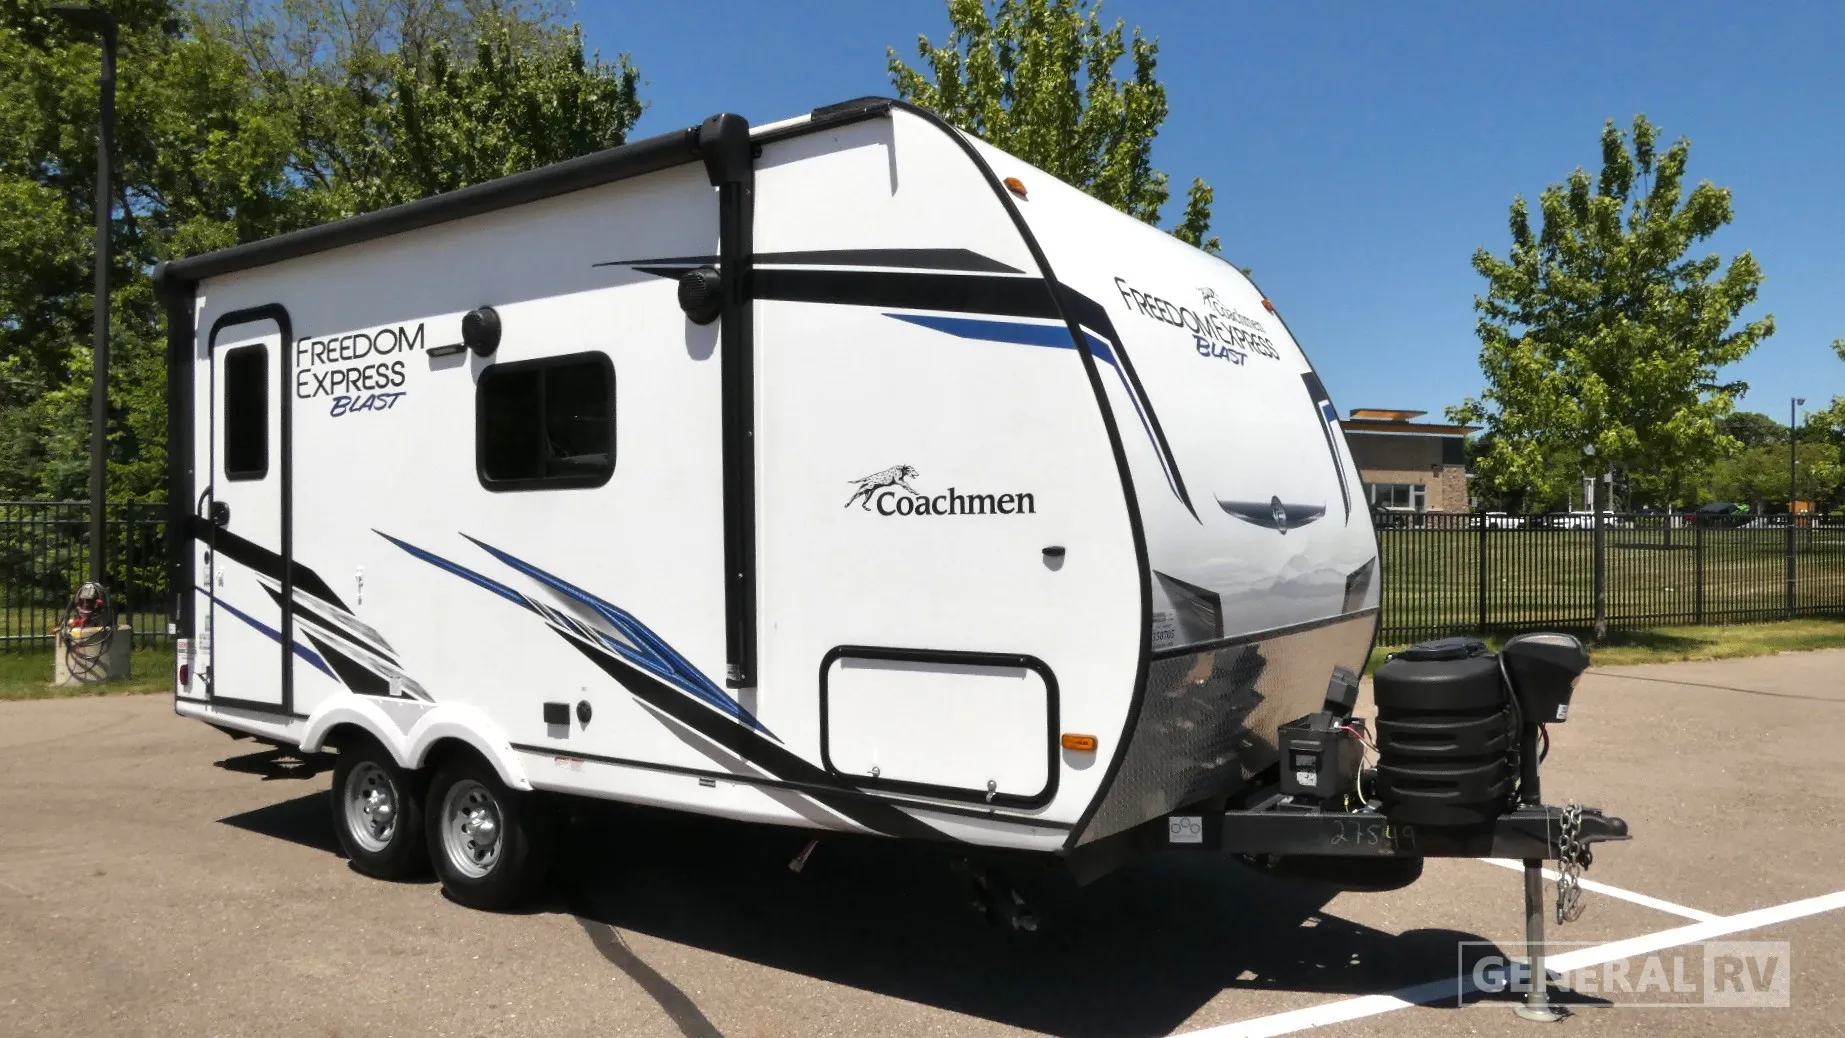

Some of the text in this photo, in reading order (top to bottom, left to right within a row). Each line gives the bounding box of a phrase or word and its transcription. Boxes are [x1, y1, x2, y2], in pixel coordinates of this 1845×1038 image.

[1212, 300, 1266, 333] Coachmen
[296, 322, 425, 368] FREEDOM
[1192, 333, 1248, 367] BLAST
[296, 360, 406, 399] EXPRESS
[330, 391, 406, 418] BLAST
[876, 487, 1037, 516] Coachmen
[1330, 820, 1416, 849] 27549
